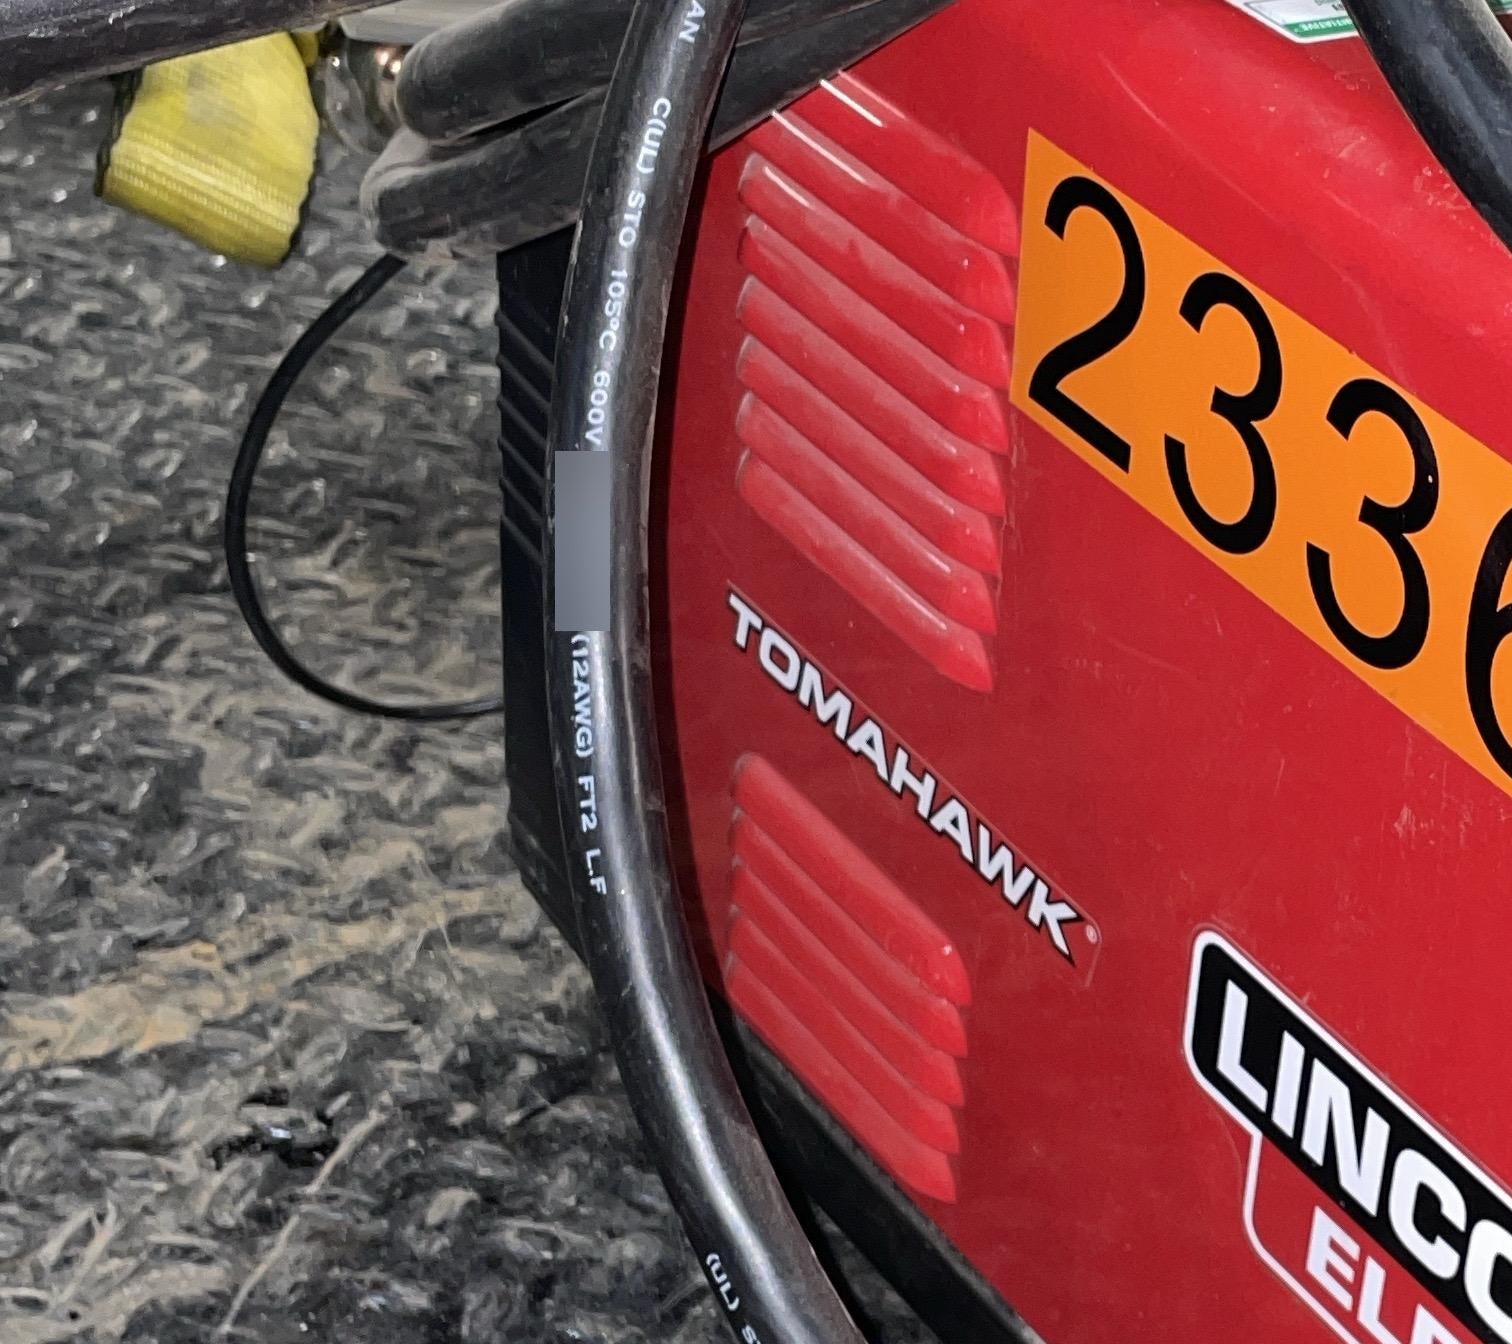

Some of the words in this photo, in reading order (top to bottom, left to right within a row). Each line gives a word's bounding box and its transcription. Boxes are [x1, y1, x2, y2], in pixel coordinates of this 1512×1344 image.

[618, 189, 647, 248] STO
[599, 268, 629, 353] 105°C
[584, 369, 611, 446] 600V
[570, 634, 596, 759] (12AWG)
[577, 774, 599, 833] FT2
[727, 591, 1082, 960] TOMAHAWK
[705, 1253, 740, 1312] (UL)
